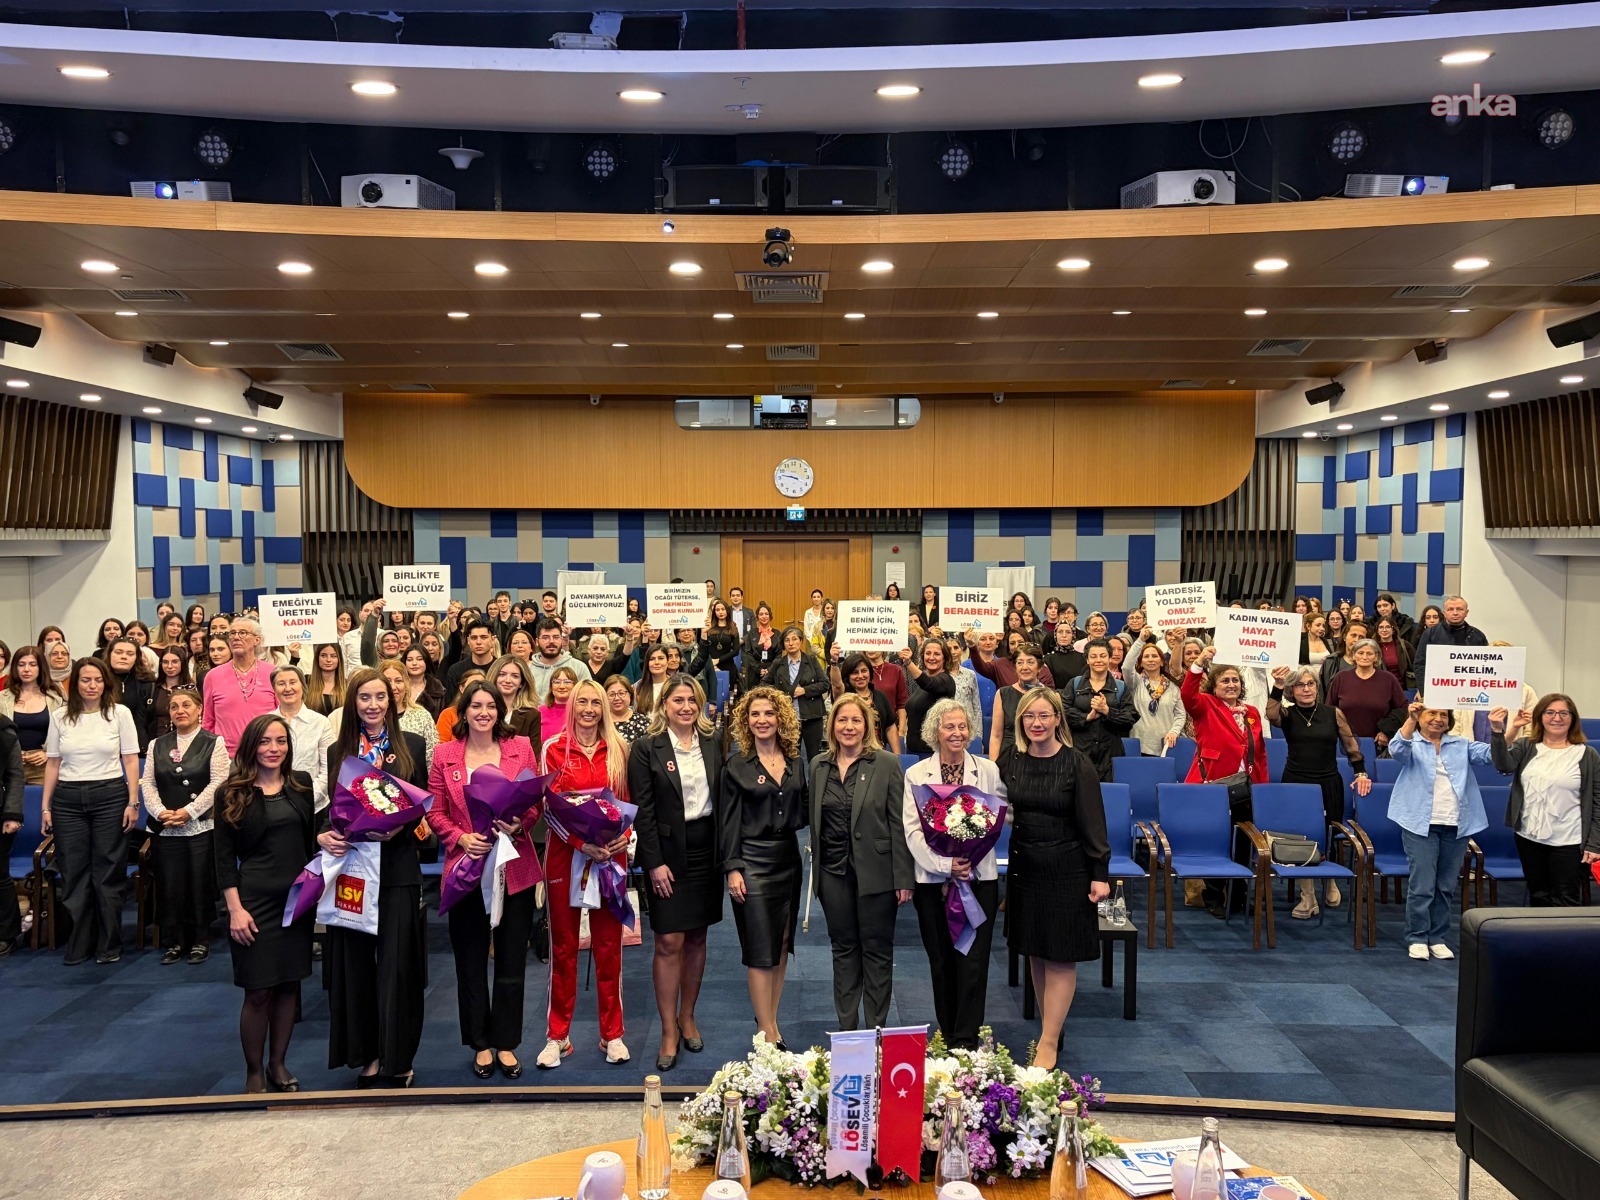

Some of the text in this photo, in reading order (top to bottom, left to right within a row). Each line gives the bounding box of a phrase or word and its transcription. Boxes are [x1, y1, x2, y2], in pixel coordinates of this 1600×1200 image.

[393, 570, 440, 580] BİRLİKTE
[390, 584, 444, 594] GÜÇLÜYÜZ
[1154, 586, 1206, 596] KARDEŞİZ,
[956, 591, 988, 603] BİRİZ
[1156, 596, 1206, 606] YOLDAŞIZ,
[272, 598, 323, 608] EMEĞİYLE
[569, 600, 624, 609] GÜÇLENİYORUZ!
[278, 608, 318, 617] ÜRETEN
[876, 606, 895, 615] İÇİN,
[944, 606, 1000, 616] BERABERİZ
[1167, 607, 1195, 615] OMUZ
[283, 618, 314, 627] KADIN
[876, 617, 895, 625] İÇİN,
[1158, 617, 1206, 626] OMUZAYIZ
[1229, 614, 1290, 626] KADIN VARSA
[880, 627, 898, 636] İÇİN:
[1242, 626, 1274, 636] HAYAT
[850, 638, 894, 646] DAYANIŞMA
[1238, 638, 1276, 648] VARDIR
[1450, 653, 1503, 662] DAYANIŞMA
[1454, 665, 1497, 676] EKELİM,
[1432, 678, 1517, 690] UMUT BİÇELİM
[338, 884, 362, 902] LSV
[862, 1092, 871, 1122] Çocuklar
[845, 1096, 860, 1152] LÖSEV
